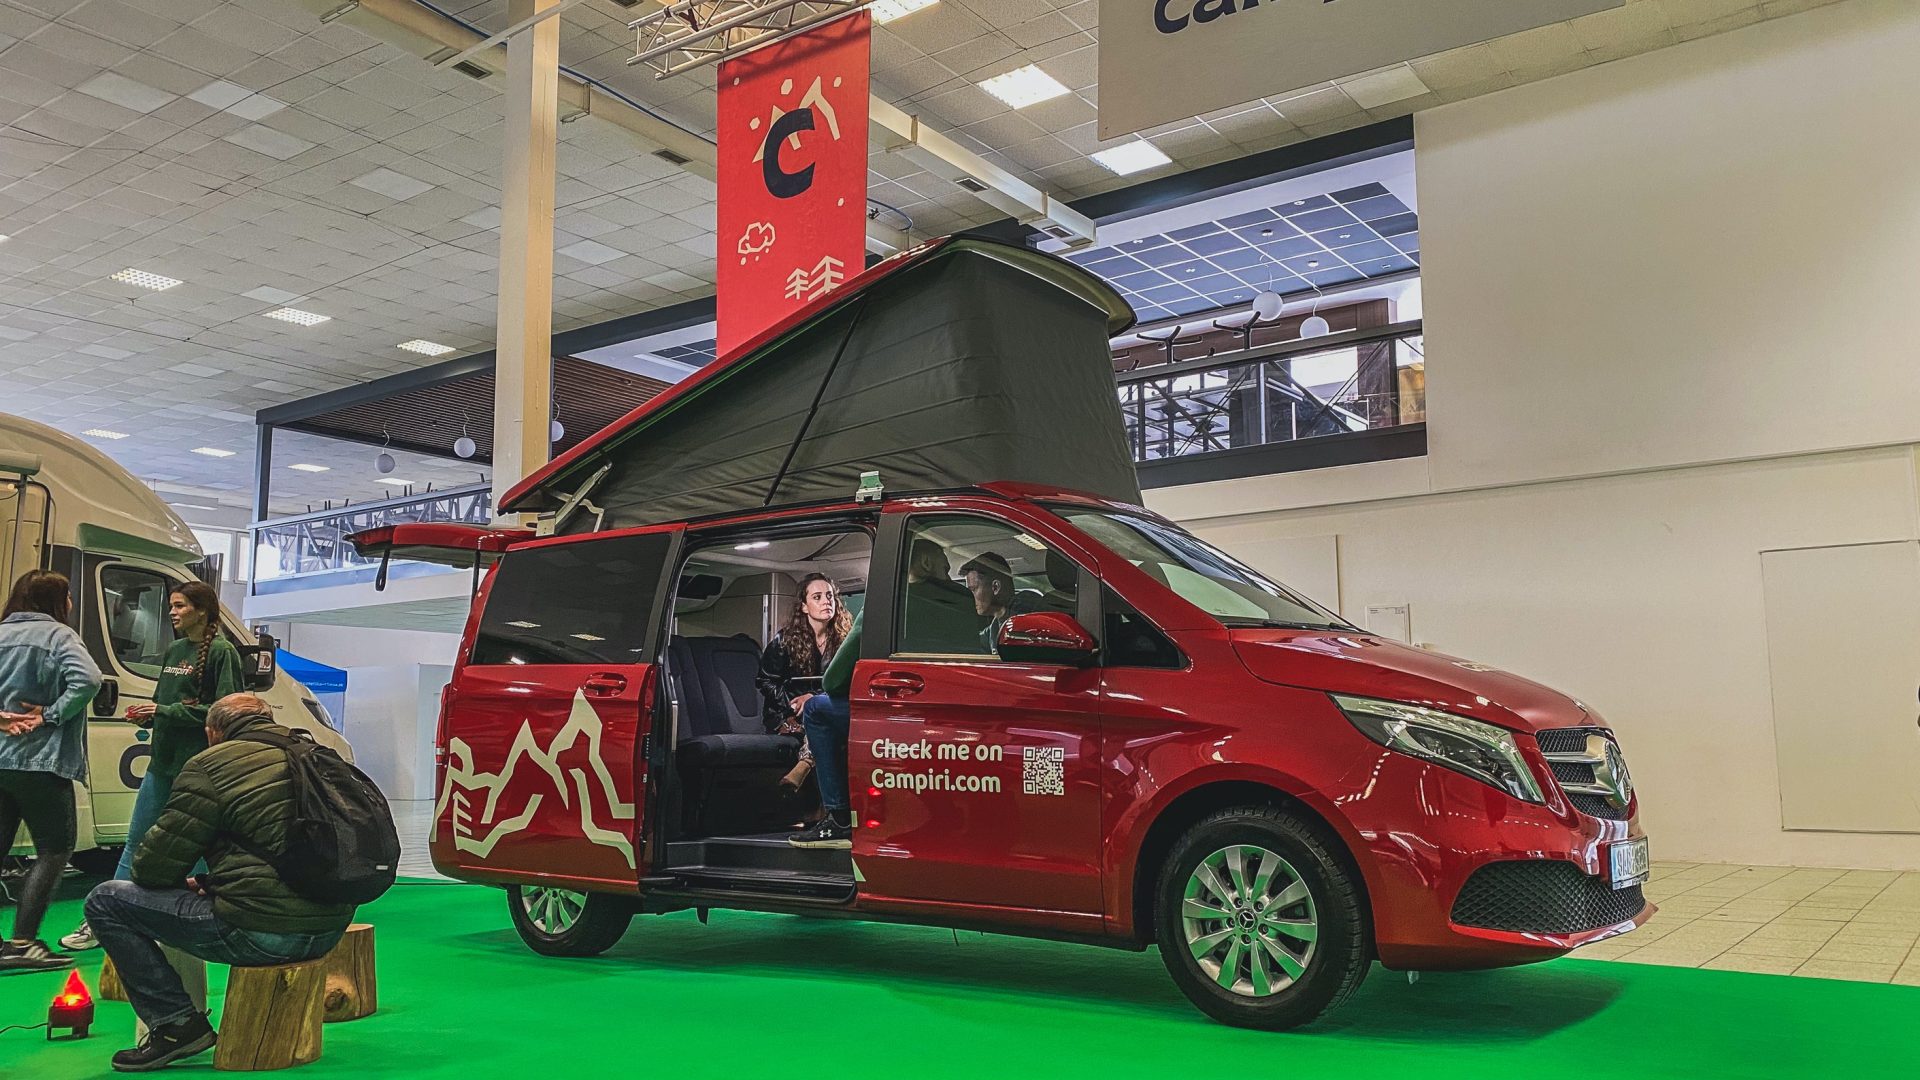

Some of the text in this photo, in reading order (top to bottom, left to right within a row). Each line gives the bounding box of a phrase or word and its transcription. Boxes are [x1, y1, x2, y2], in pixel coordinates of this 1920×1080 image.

[871, 738, 1003, 762] Check me on
[871, 768, 1001, 794] Campiri.com
